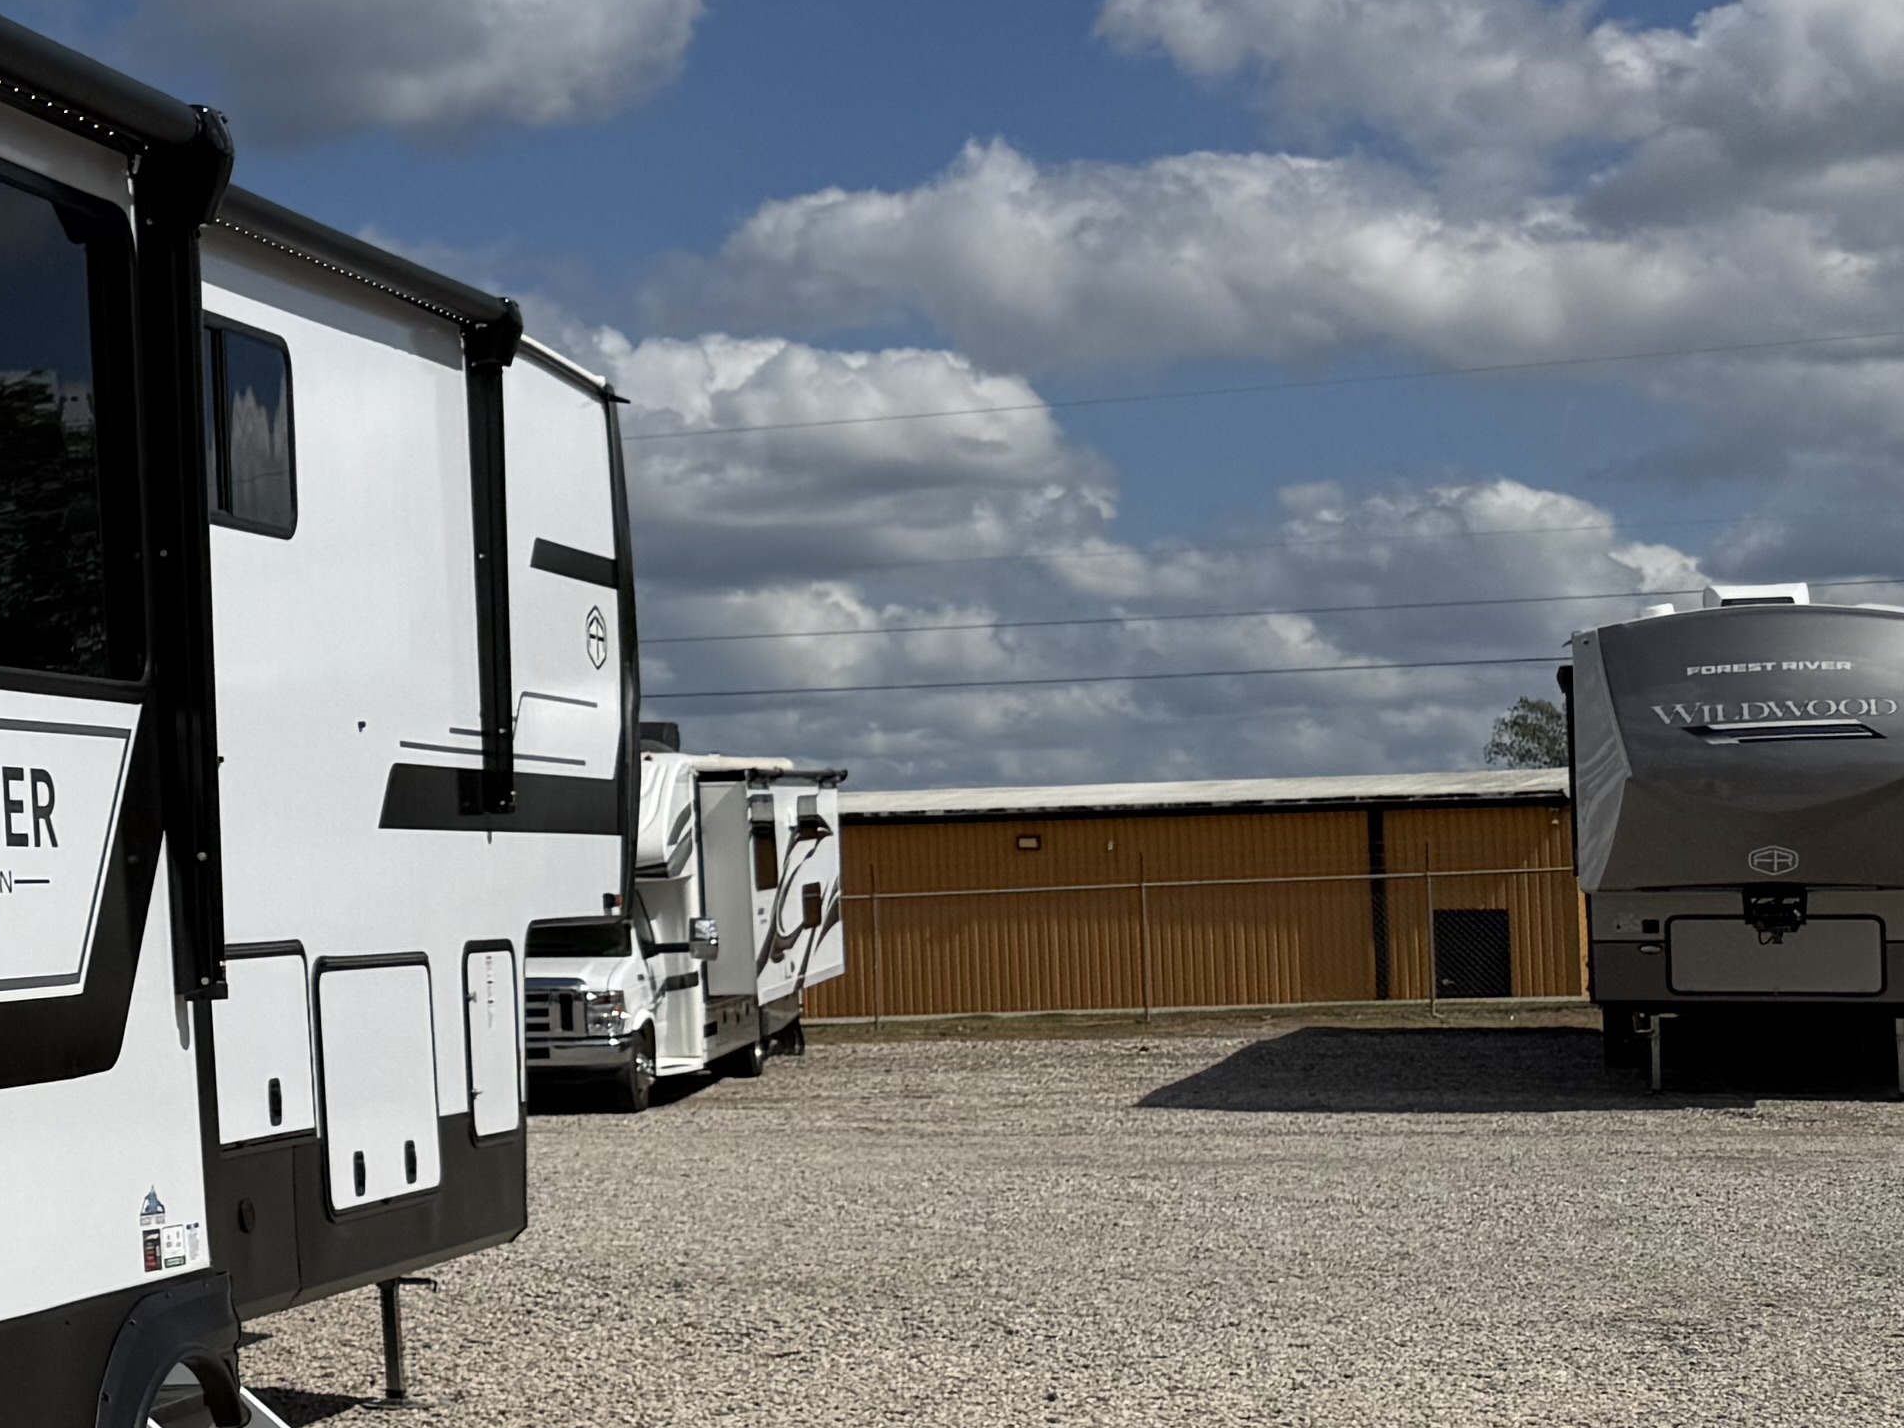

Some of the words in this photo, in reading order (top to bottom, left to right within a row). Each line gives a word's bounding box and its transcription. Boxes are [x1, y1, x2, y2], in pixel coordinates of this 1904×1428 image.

[1686, 661, 1777, 676] FOREST
[1781, 660, 1852, 671] RIVER
[1650, 698, 1898, 725] WILDWOOD
